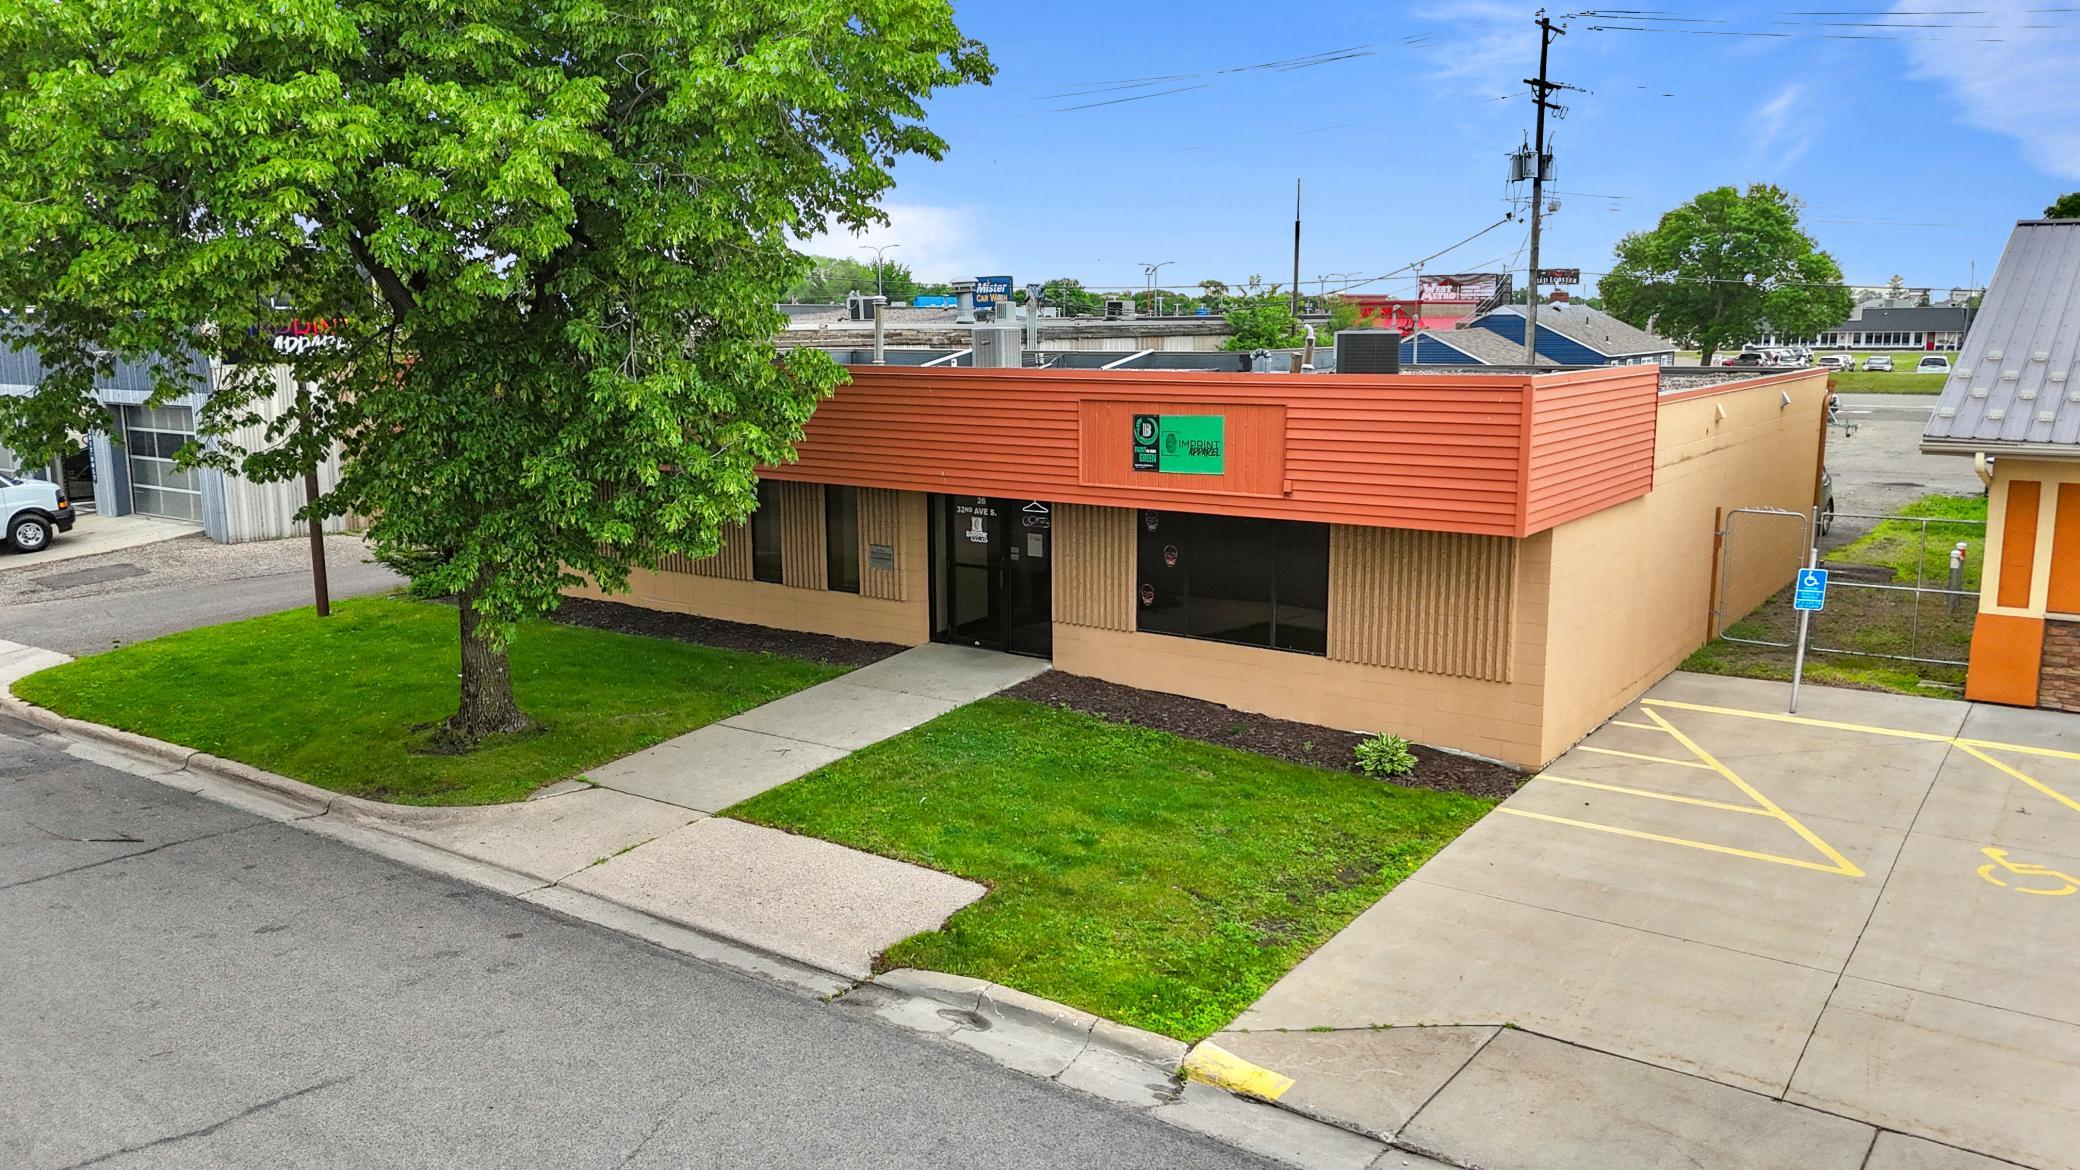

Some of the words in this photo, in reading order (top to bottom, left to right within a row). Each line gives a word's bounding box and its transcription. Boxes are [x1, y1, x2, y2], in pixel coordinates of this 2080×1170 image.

[976, 282, 1007, 293] Mister
[976, 294, 989, 302] CAR
[1421, 292, 1456, 300] METRO
[1179, 440, 1220, 449] IMPRINT
[1188, 447, 1221, 456] APPAREL
